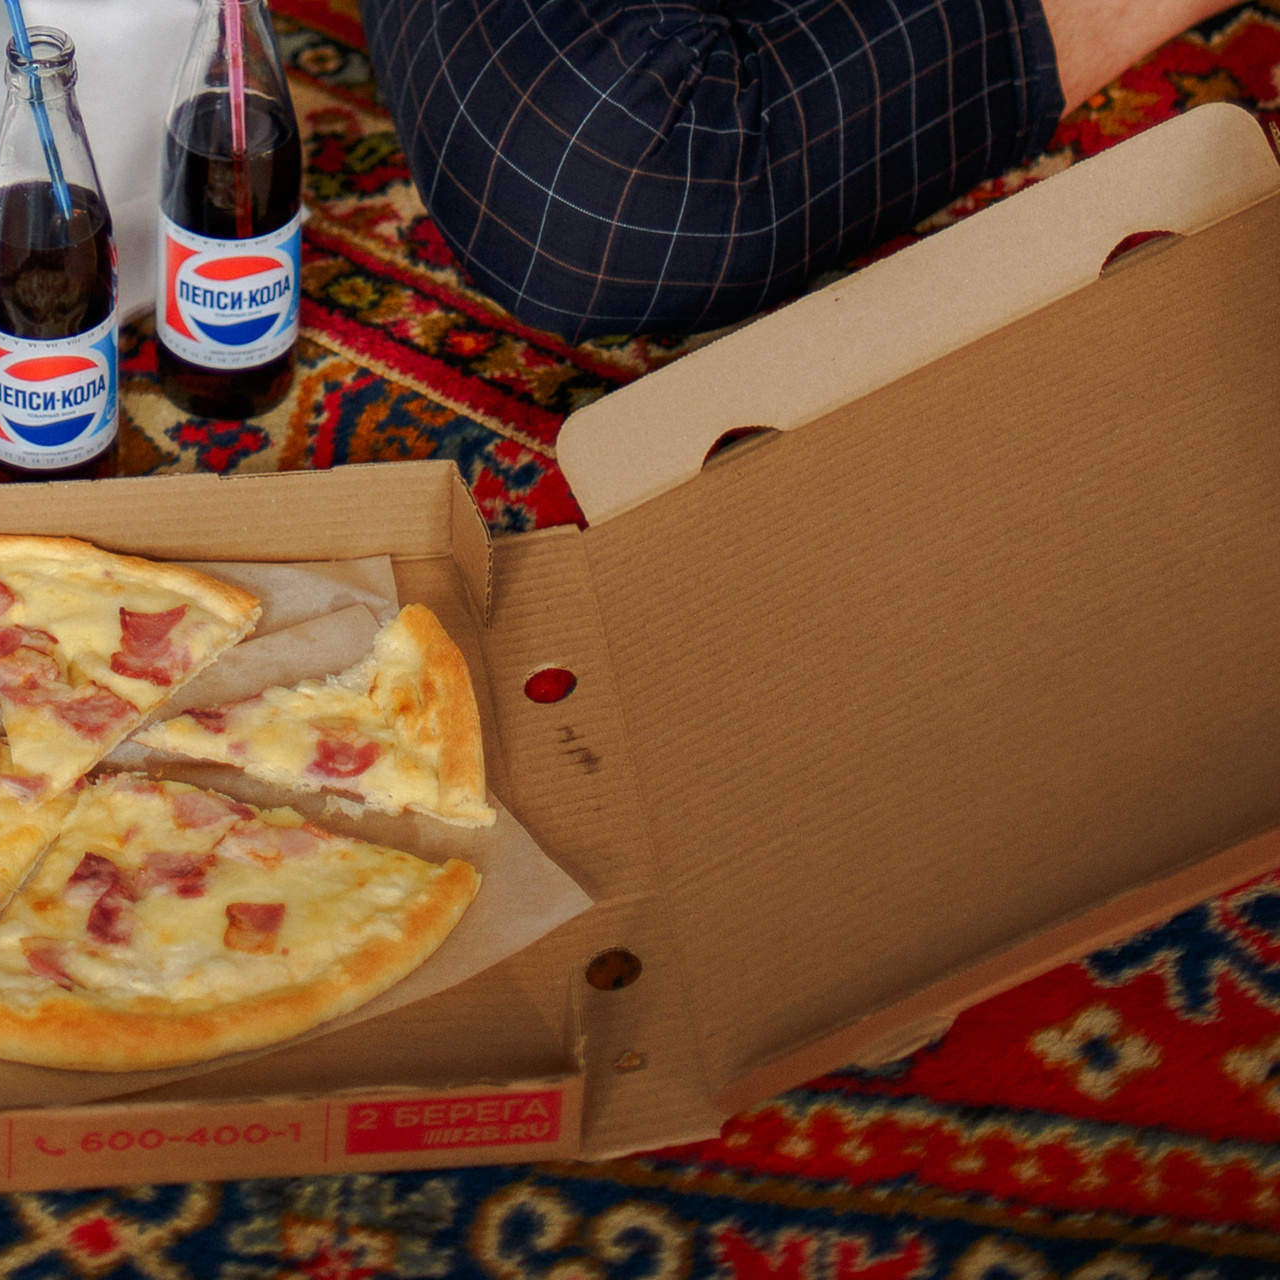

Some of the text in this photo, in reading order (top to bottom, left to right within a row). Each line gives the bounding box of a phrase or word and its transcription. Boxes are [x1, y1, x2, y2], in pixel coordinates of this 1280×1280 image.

[179, 275, 291, 310] ПЕПСИ-КОЛА
[356, 1098, 549, 1131] 2 БЕРЕГА
[80, 1123, 302, 1153] 600-400-1
